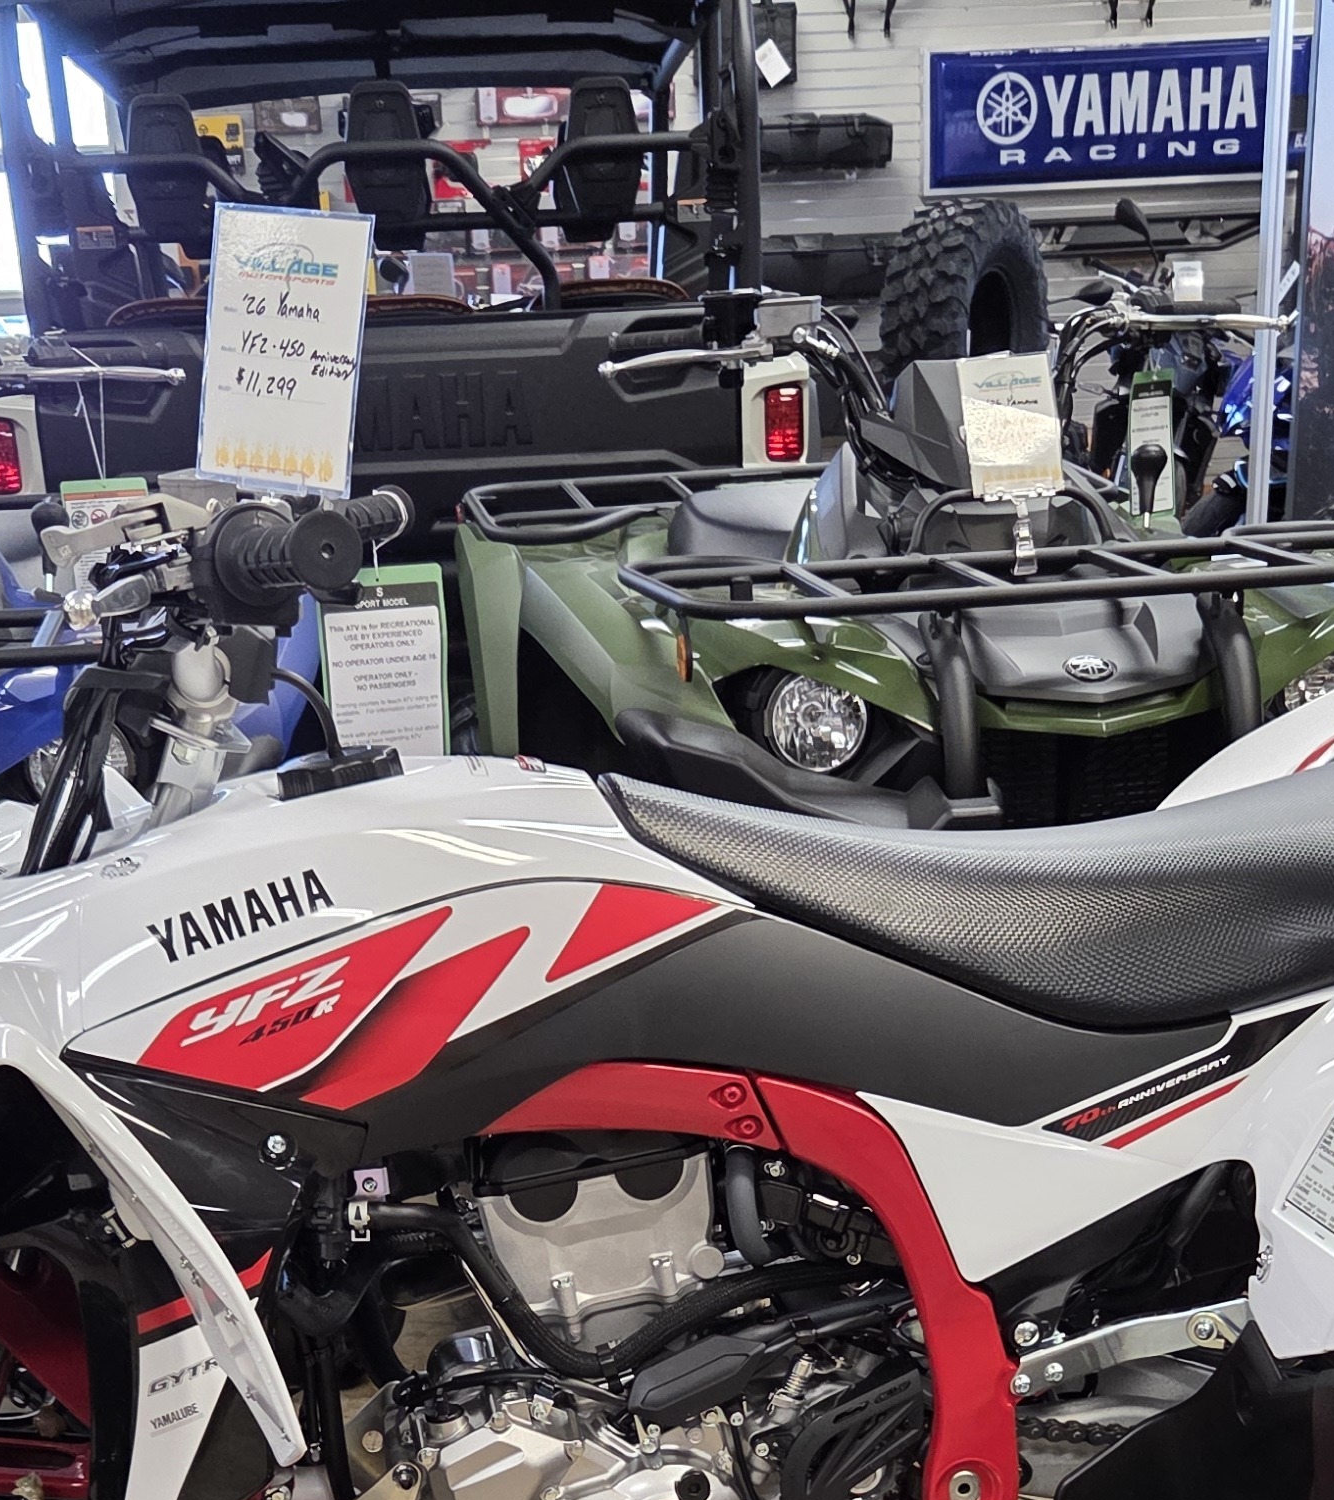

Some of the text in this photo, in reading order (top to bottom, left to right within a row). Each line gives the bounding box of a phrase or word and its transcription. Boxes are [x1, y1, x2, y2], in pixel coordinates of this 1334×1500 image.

[1042, 65, 1257, 138] YAMAHA
[999, 138, 1241, 166] RACING
[233, 254, 339, 278] VILLAGE
[238, 271, 336, 286] MOTORSPORTS
[277, 291, 320, 322] Yamaha
[235, 366, 297, 400] $11,299
[311, 365, 349, 381] Edition
[972, 376, 1042, 389] VILLAGE
[356, 370, 534, 452] MAHA
[376, 587, 383, 597] S
[383, 598, 409, 607] MODEL
[344, 634, 358, 642] USE
[372, 629, 423, 639] EXPERIENCED
[380, 619, 435, 629] RECREATIONAL
[350, 642, 394, 651] OPERATORS
[345, 658, 384, 667] OPERATOR
[387, 655, 411, 664] UNDER
[353, 672, 393, 682] OPERATOR
[369, 680, 416, 690] PASSENGERS
[146, 869, 334, 963] YAMAHA
[180, 956, 351, 1047] YFZ
[238, 993, 341, 1047] 450R
[1062, 1055, 1231, 1131] 70th ANNIVERSARY
[147, 1357, 219, 1397] GYTR
[150, 1403, 200, 1429] YAMALUBE
